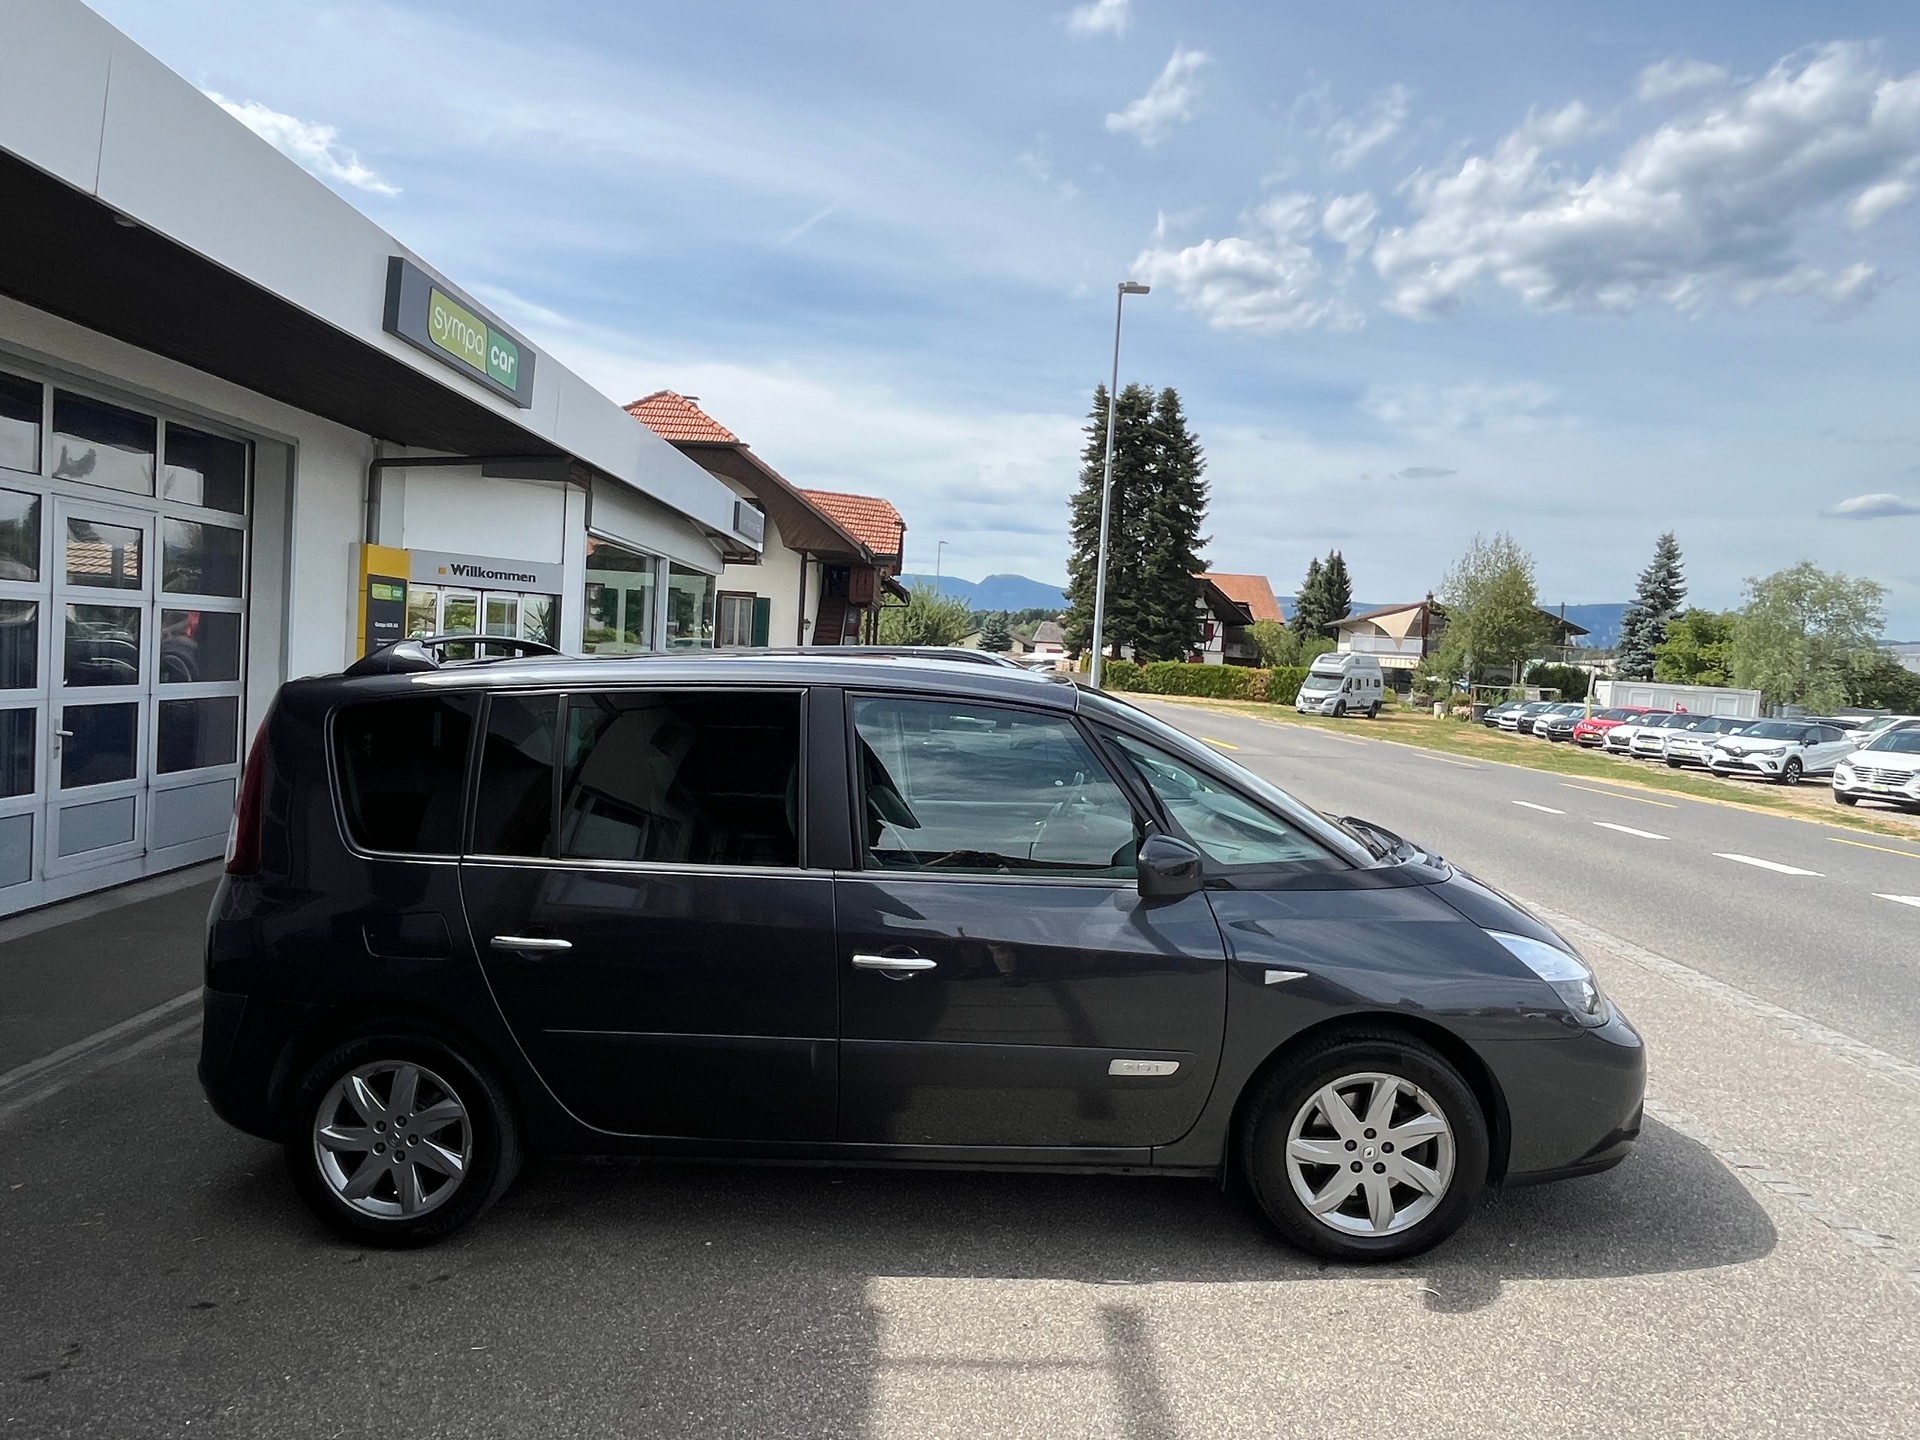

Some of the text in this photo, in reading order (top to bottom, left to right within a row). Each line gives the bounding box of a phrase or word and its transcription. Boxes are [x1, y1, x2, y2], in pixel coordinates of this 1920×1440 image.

[434, 306, 515, 374] sympa car
[450, 563, 537, 583] Willkommen
